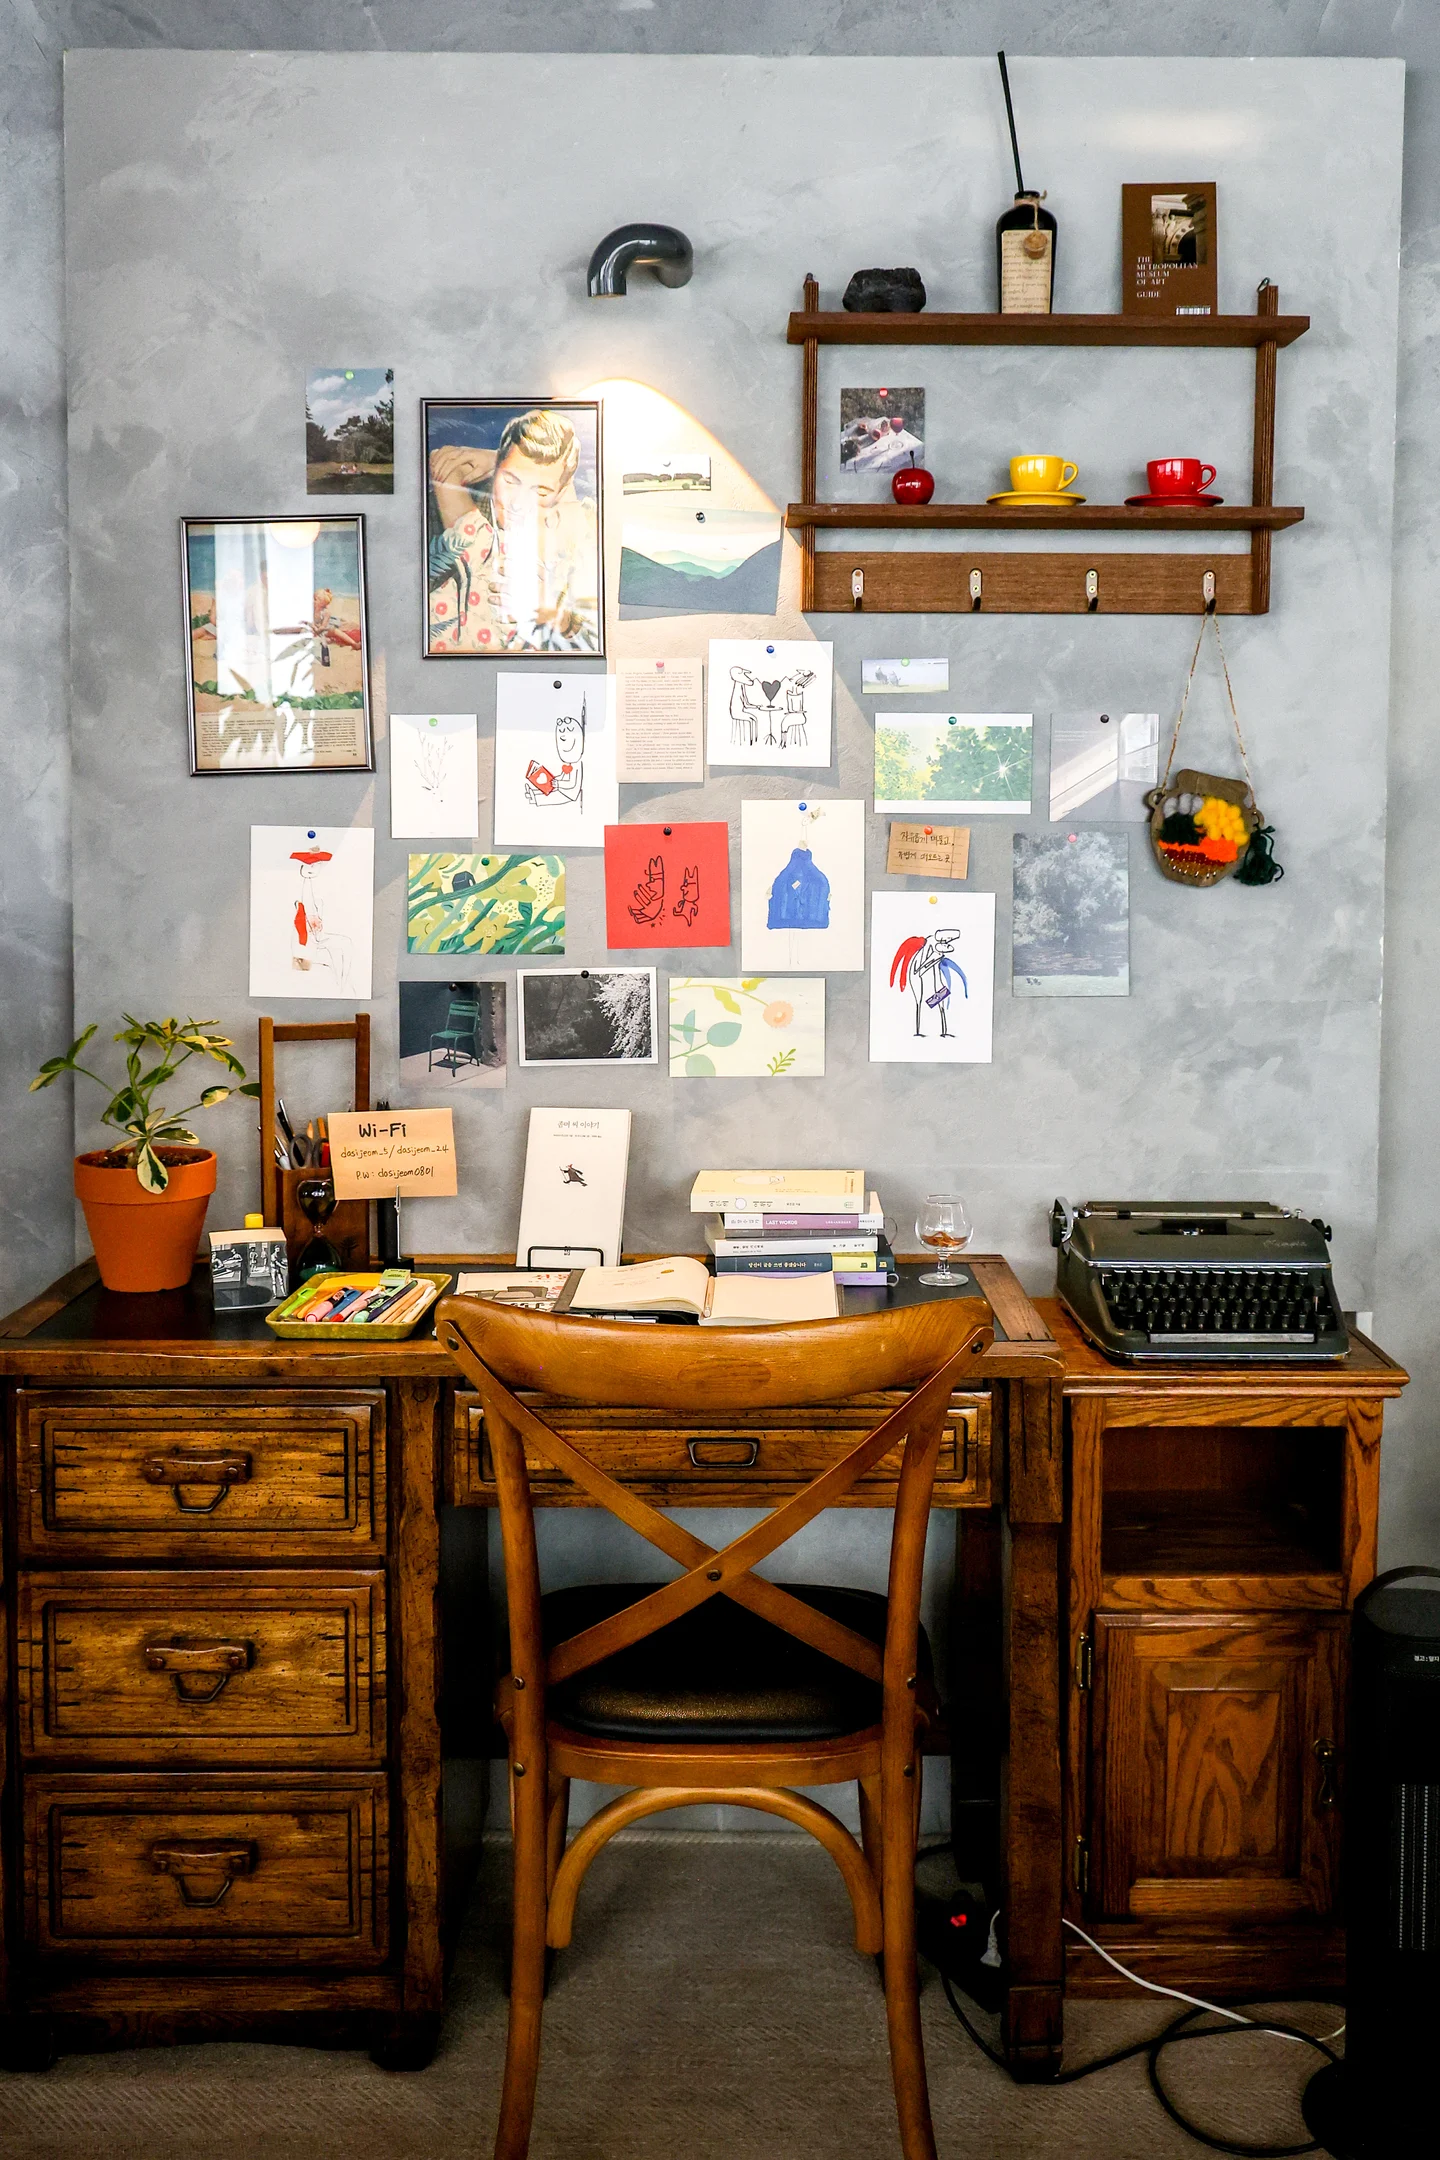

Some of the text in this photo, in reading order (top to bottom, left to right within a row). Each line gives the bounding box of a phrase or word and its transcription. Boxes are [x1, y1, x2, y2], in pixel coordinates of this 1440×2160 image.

[1136, 262, 1198, 270] METROPOLITAN
[1136, 270, 1170, 278] MUSEUM
[359, 1122, 406, 1137] Wi-Fi
